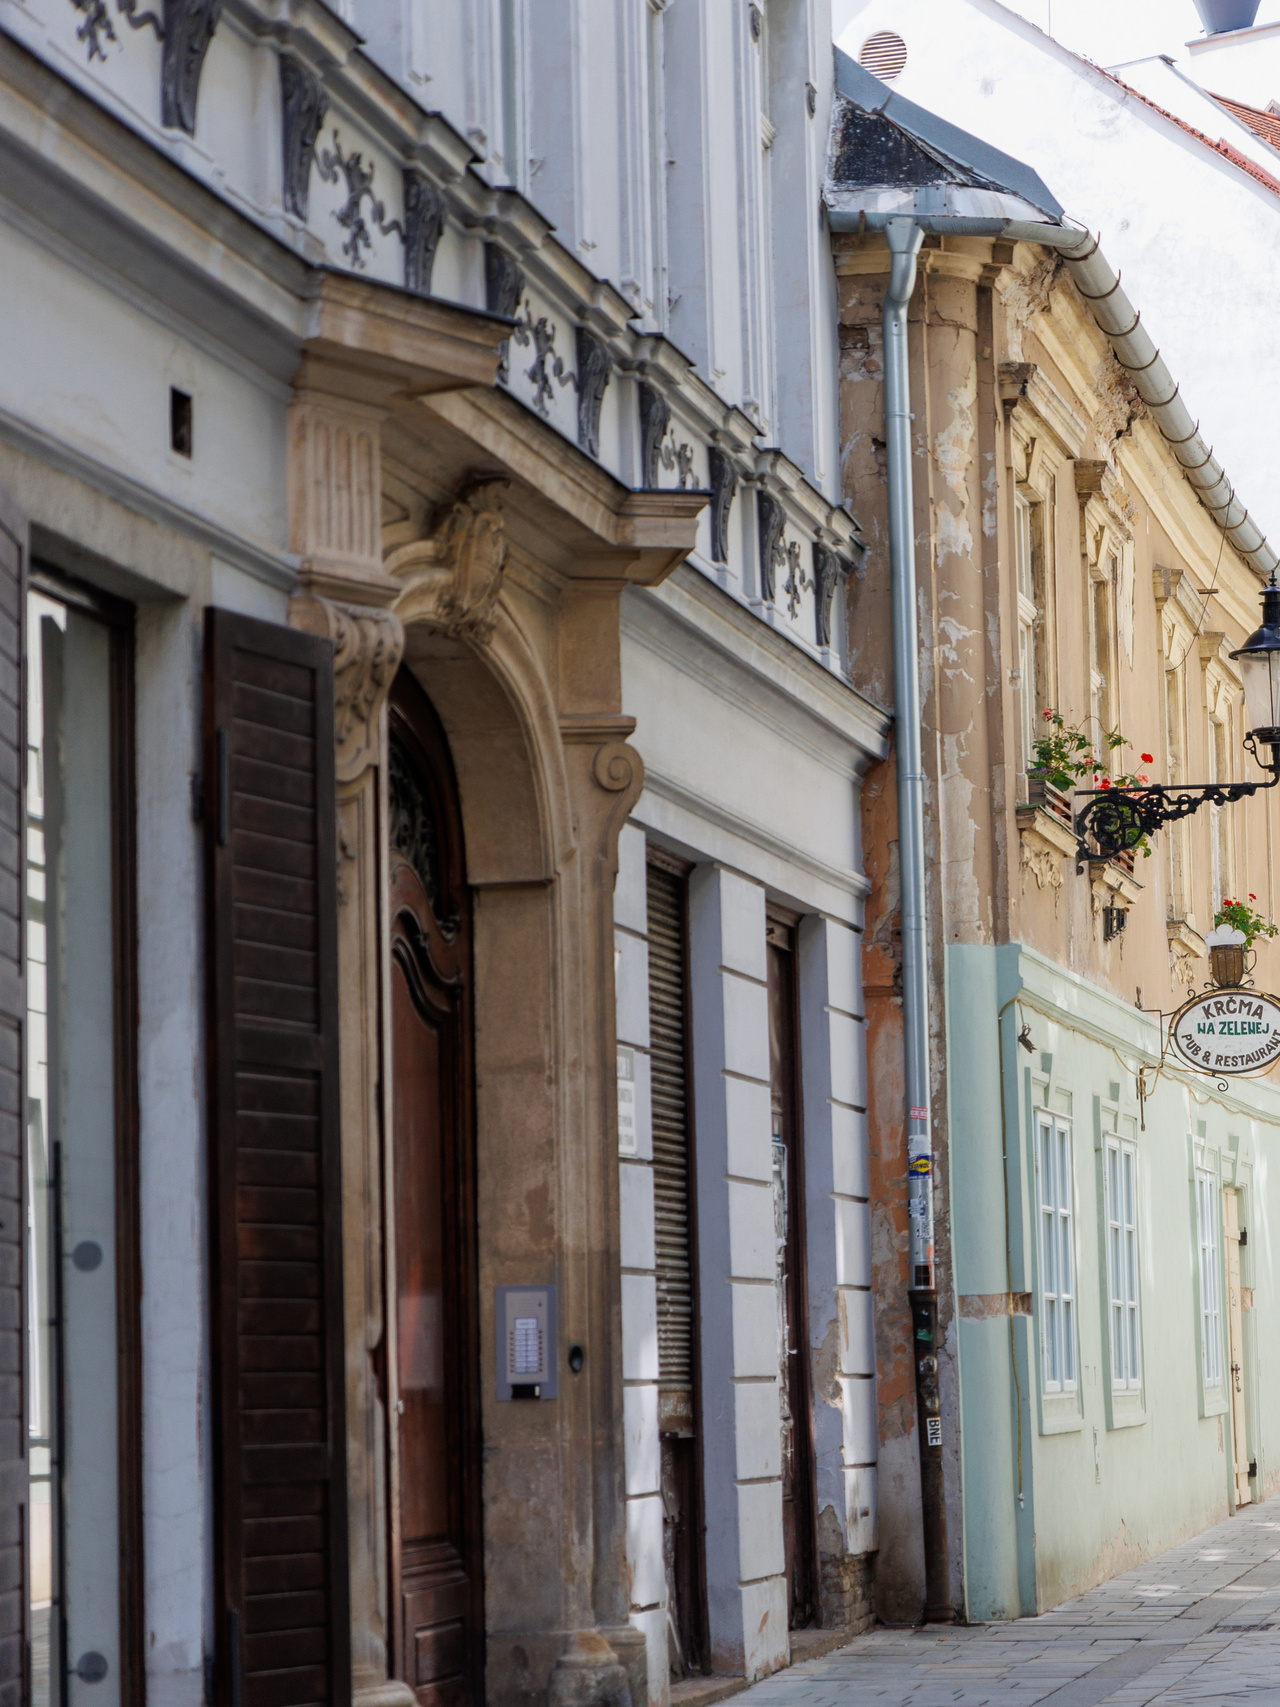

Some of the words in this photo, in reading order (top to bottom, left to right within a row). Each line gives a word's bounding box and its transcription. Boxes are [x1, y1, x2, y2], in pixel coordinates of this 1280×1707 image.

[1202, 996, 1264, 1020] KRČMA
[1197, 1022, 1215, 1035] NA
[1219, 1021, 1270, 1035] ZELENEJ
[1181, 1033, 1202, 1057] PUB
[1201, 1050, 1211, 1065] &
[929, 1420, 940, 1444] BNE
